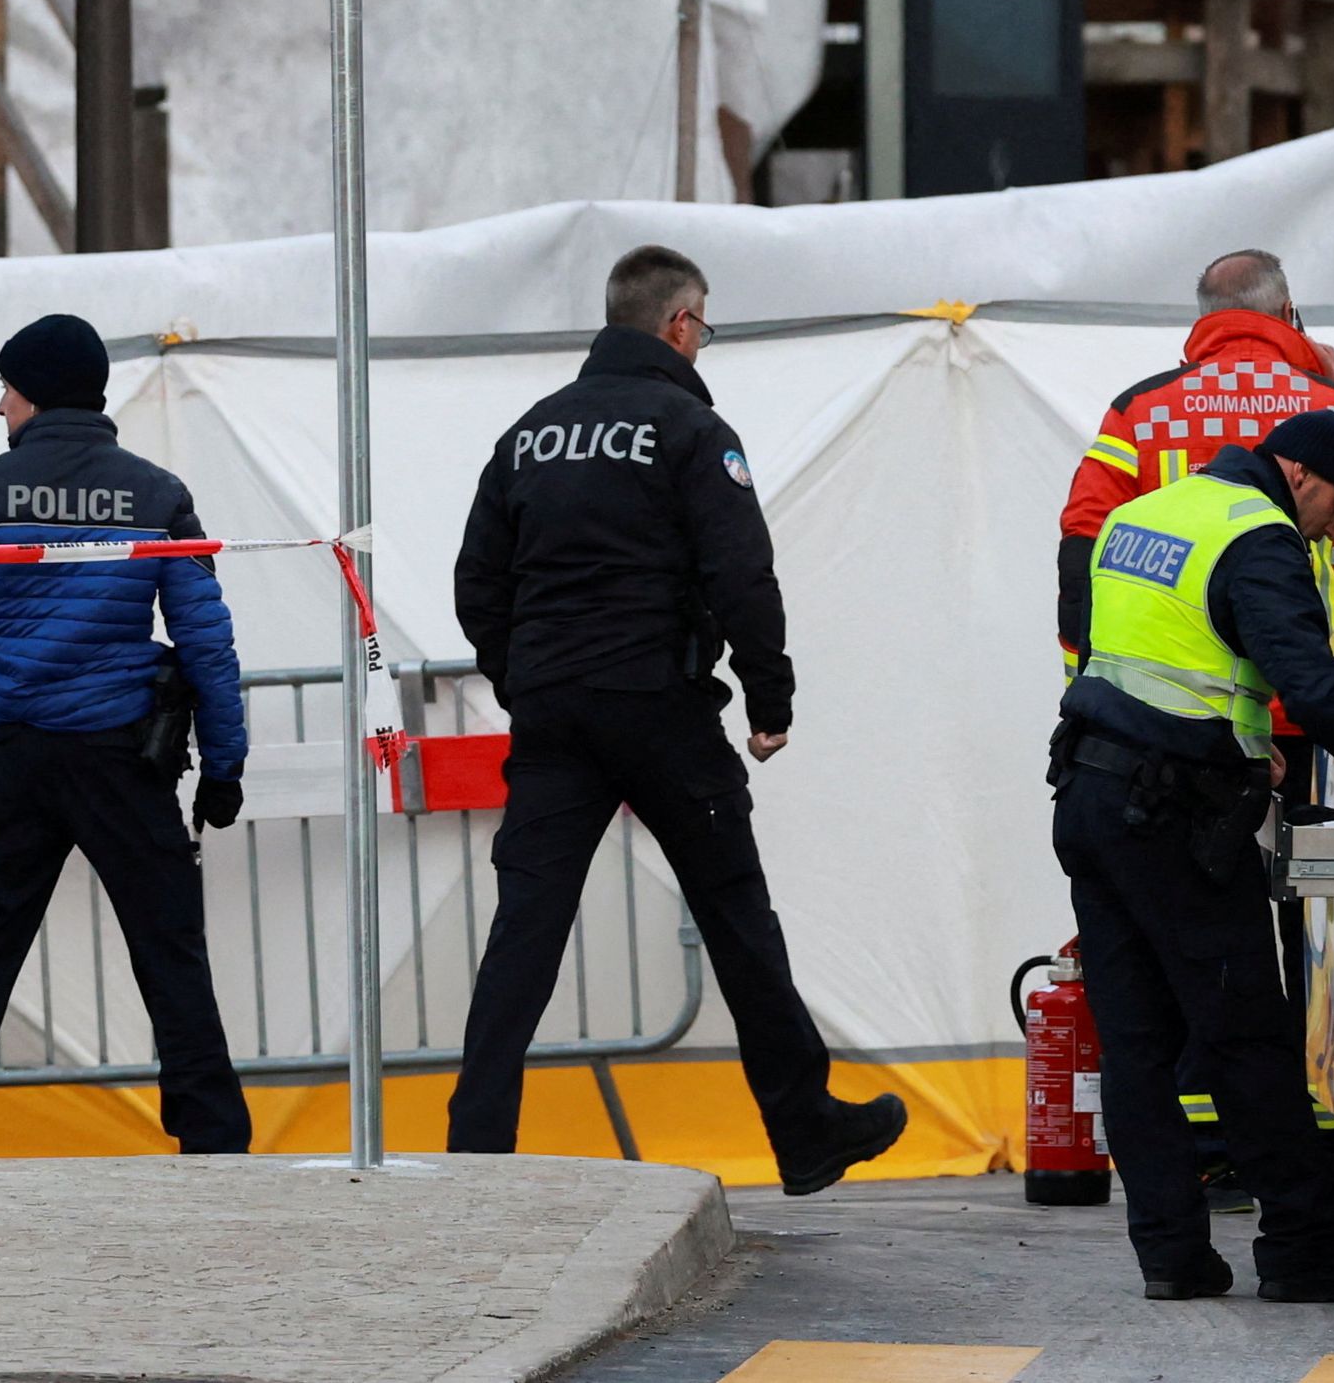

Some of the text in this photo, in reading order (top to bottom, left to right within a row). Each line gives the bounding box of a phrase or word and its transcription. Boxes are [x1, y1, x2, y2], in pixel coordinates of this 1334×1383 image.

[1184, 394, 1311, 414] COMMANDANT
[513, 421, 657, 471] POLICE
[7, 484, 134, 522] POLICE
[1101, 528, 1186, 581] POLICE
